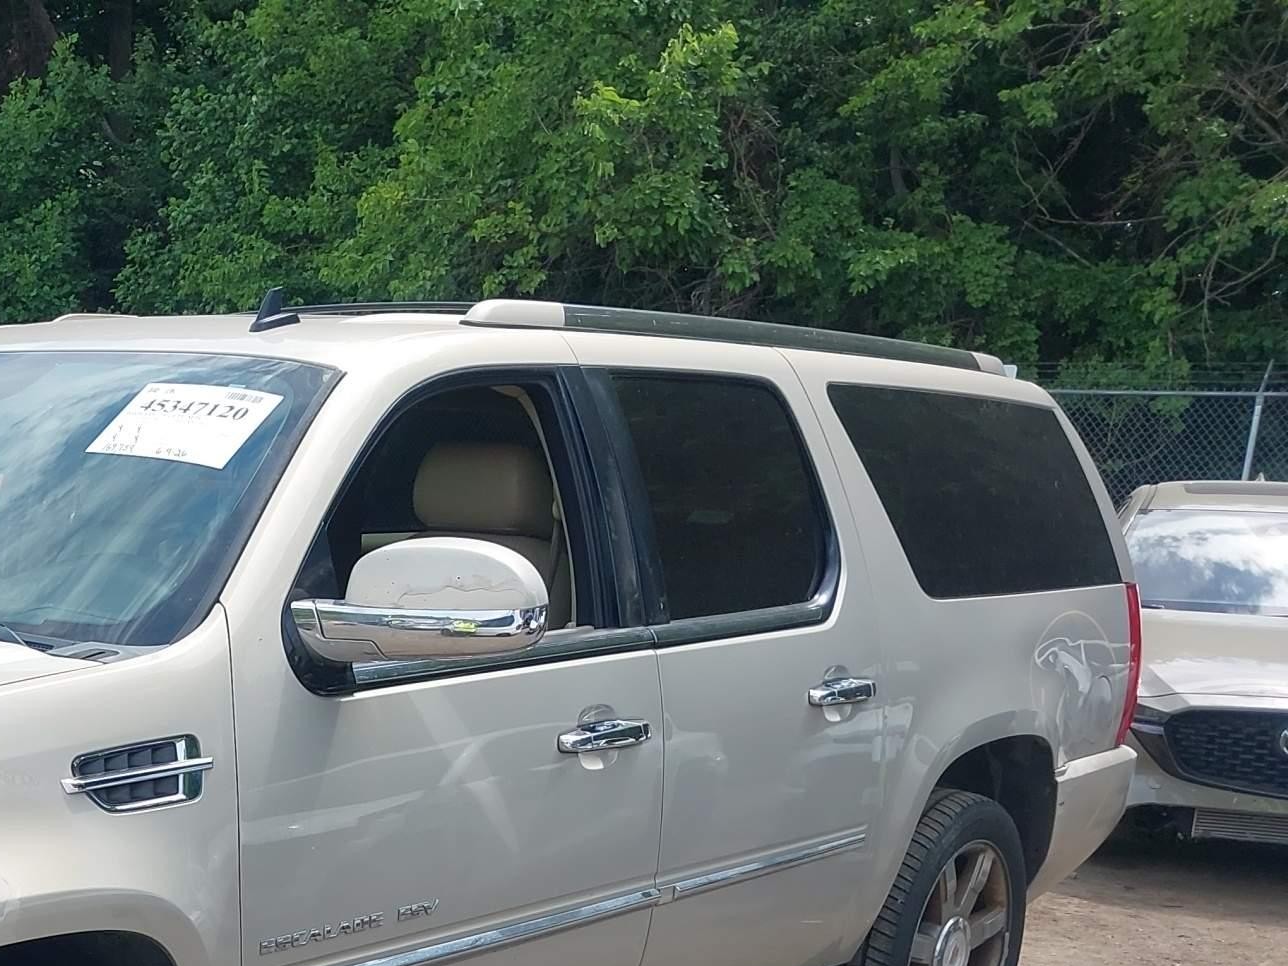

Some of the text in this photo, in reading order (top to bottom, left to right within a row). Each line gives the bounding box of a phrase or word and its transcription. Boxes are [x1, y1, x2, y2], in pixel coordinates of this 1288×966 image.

[140, 399, 249, 420] 45347120
[259, 898, 439, 956] ESCALADE ESV
